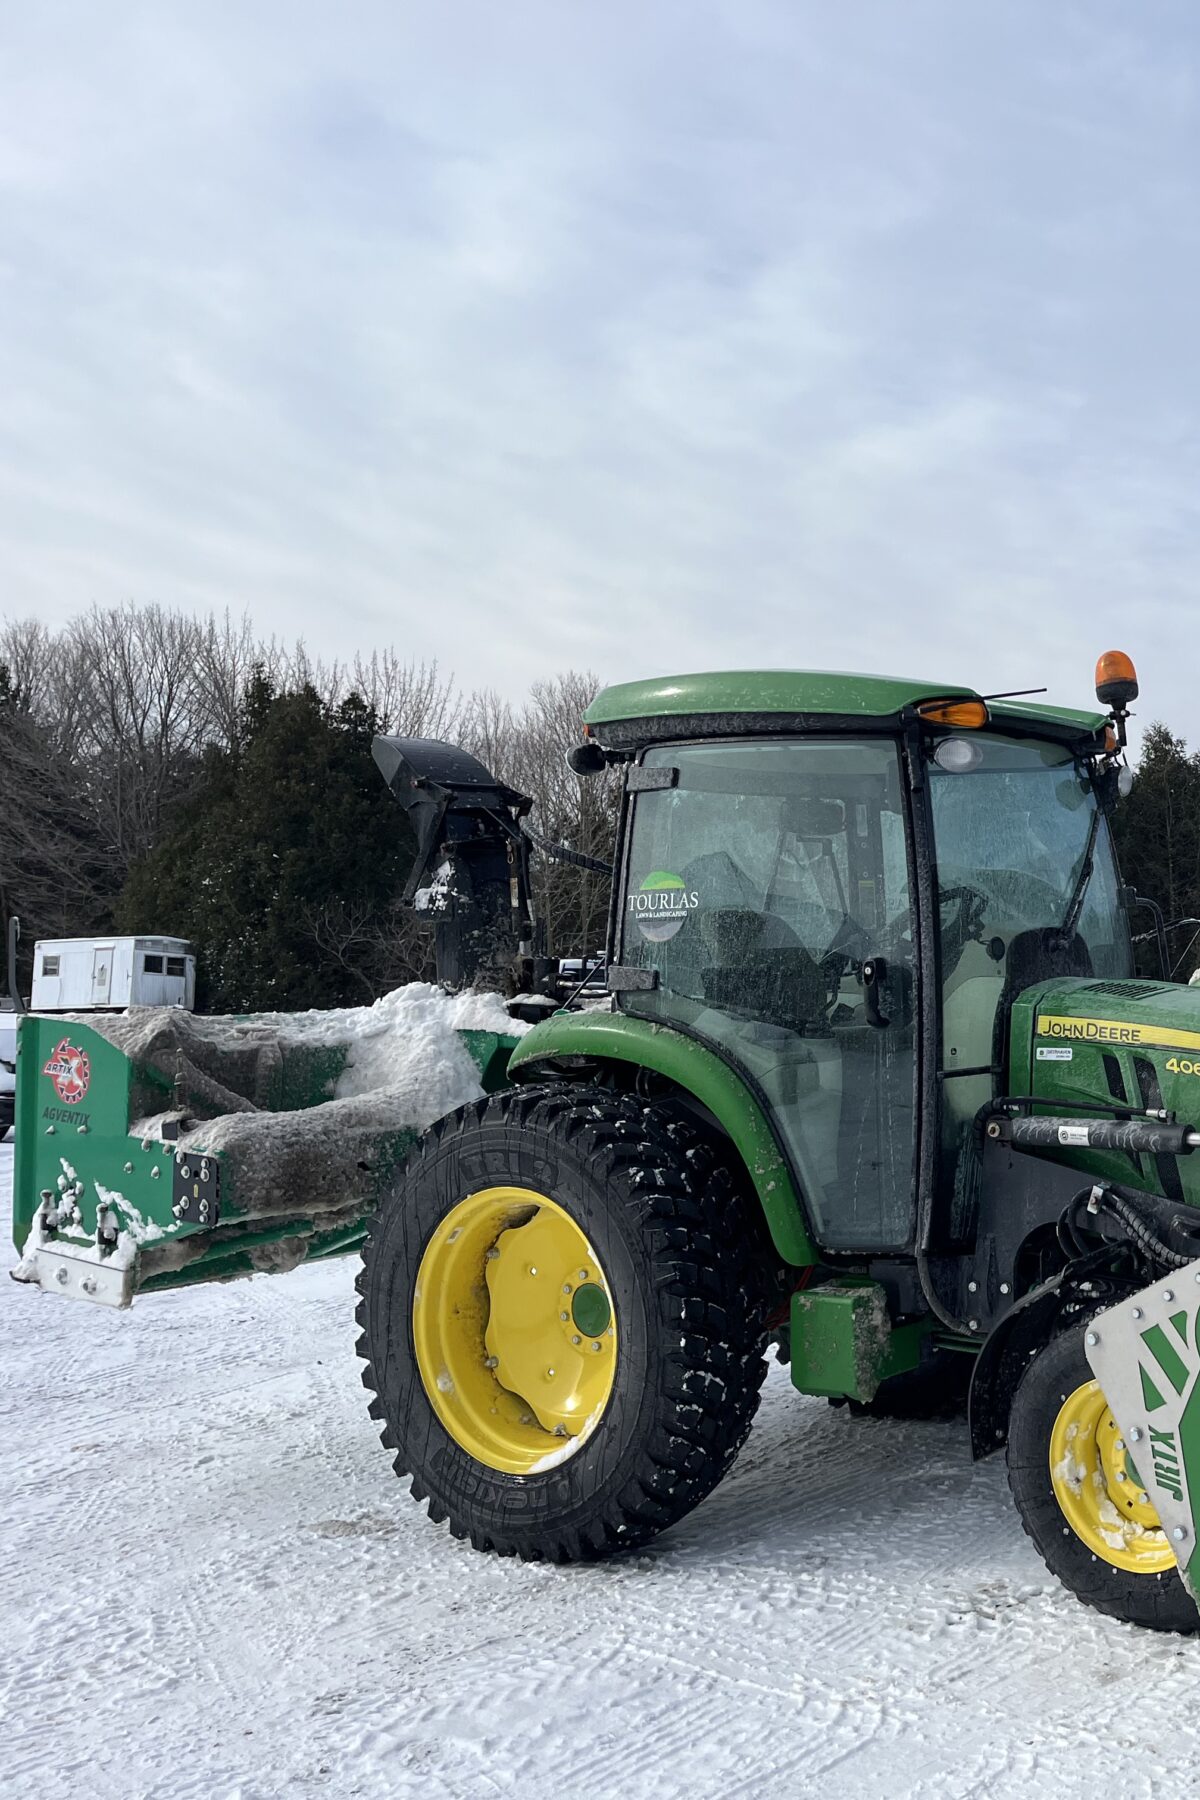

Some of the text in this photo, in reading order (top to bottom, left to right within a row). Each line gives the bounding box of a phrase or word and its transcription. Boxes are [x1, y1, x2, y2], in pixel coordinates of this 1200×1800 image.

[627, 892, 699, 911] TOURLAS
[1042, 1020, 1142, 1042] JOHN DEERE
[46, 1062, 73, 1075] ARTIX
[42, 1106, 91, 1127] AGVENTIX
[1147, 1423, 1184, 1502] JRTX
